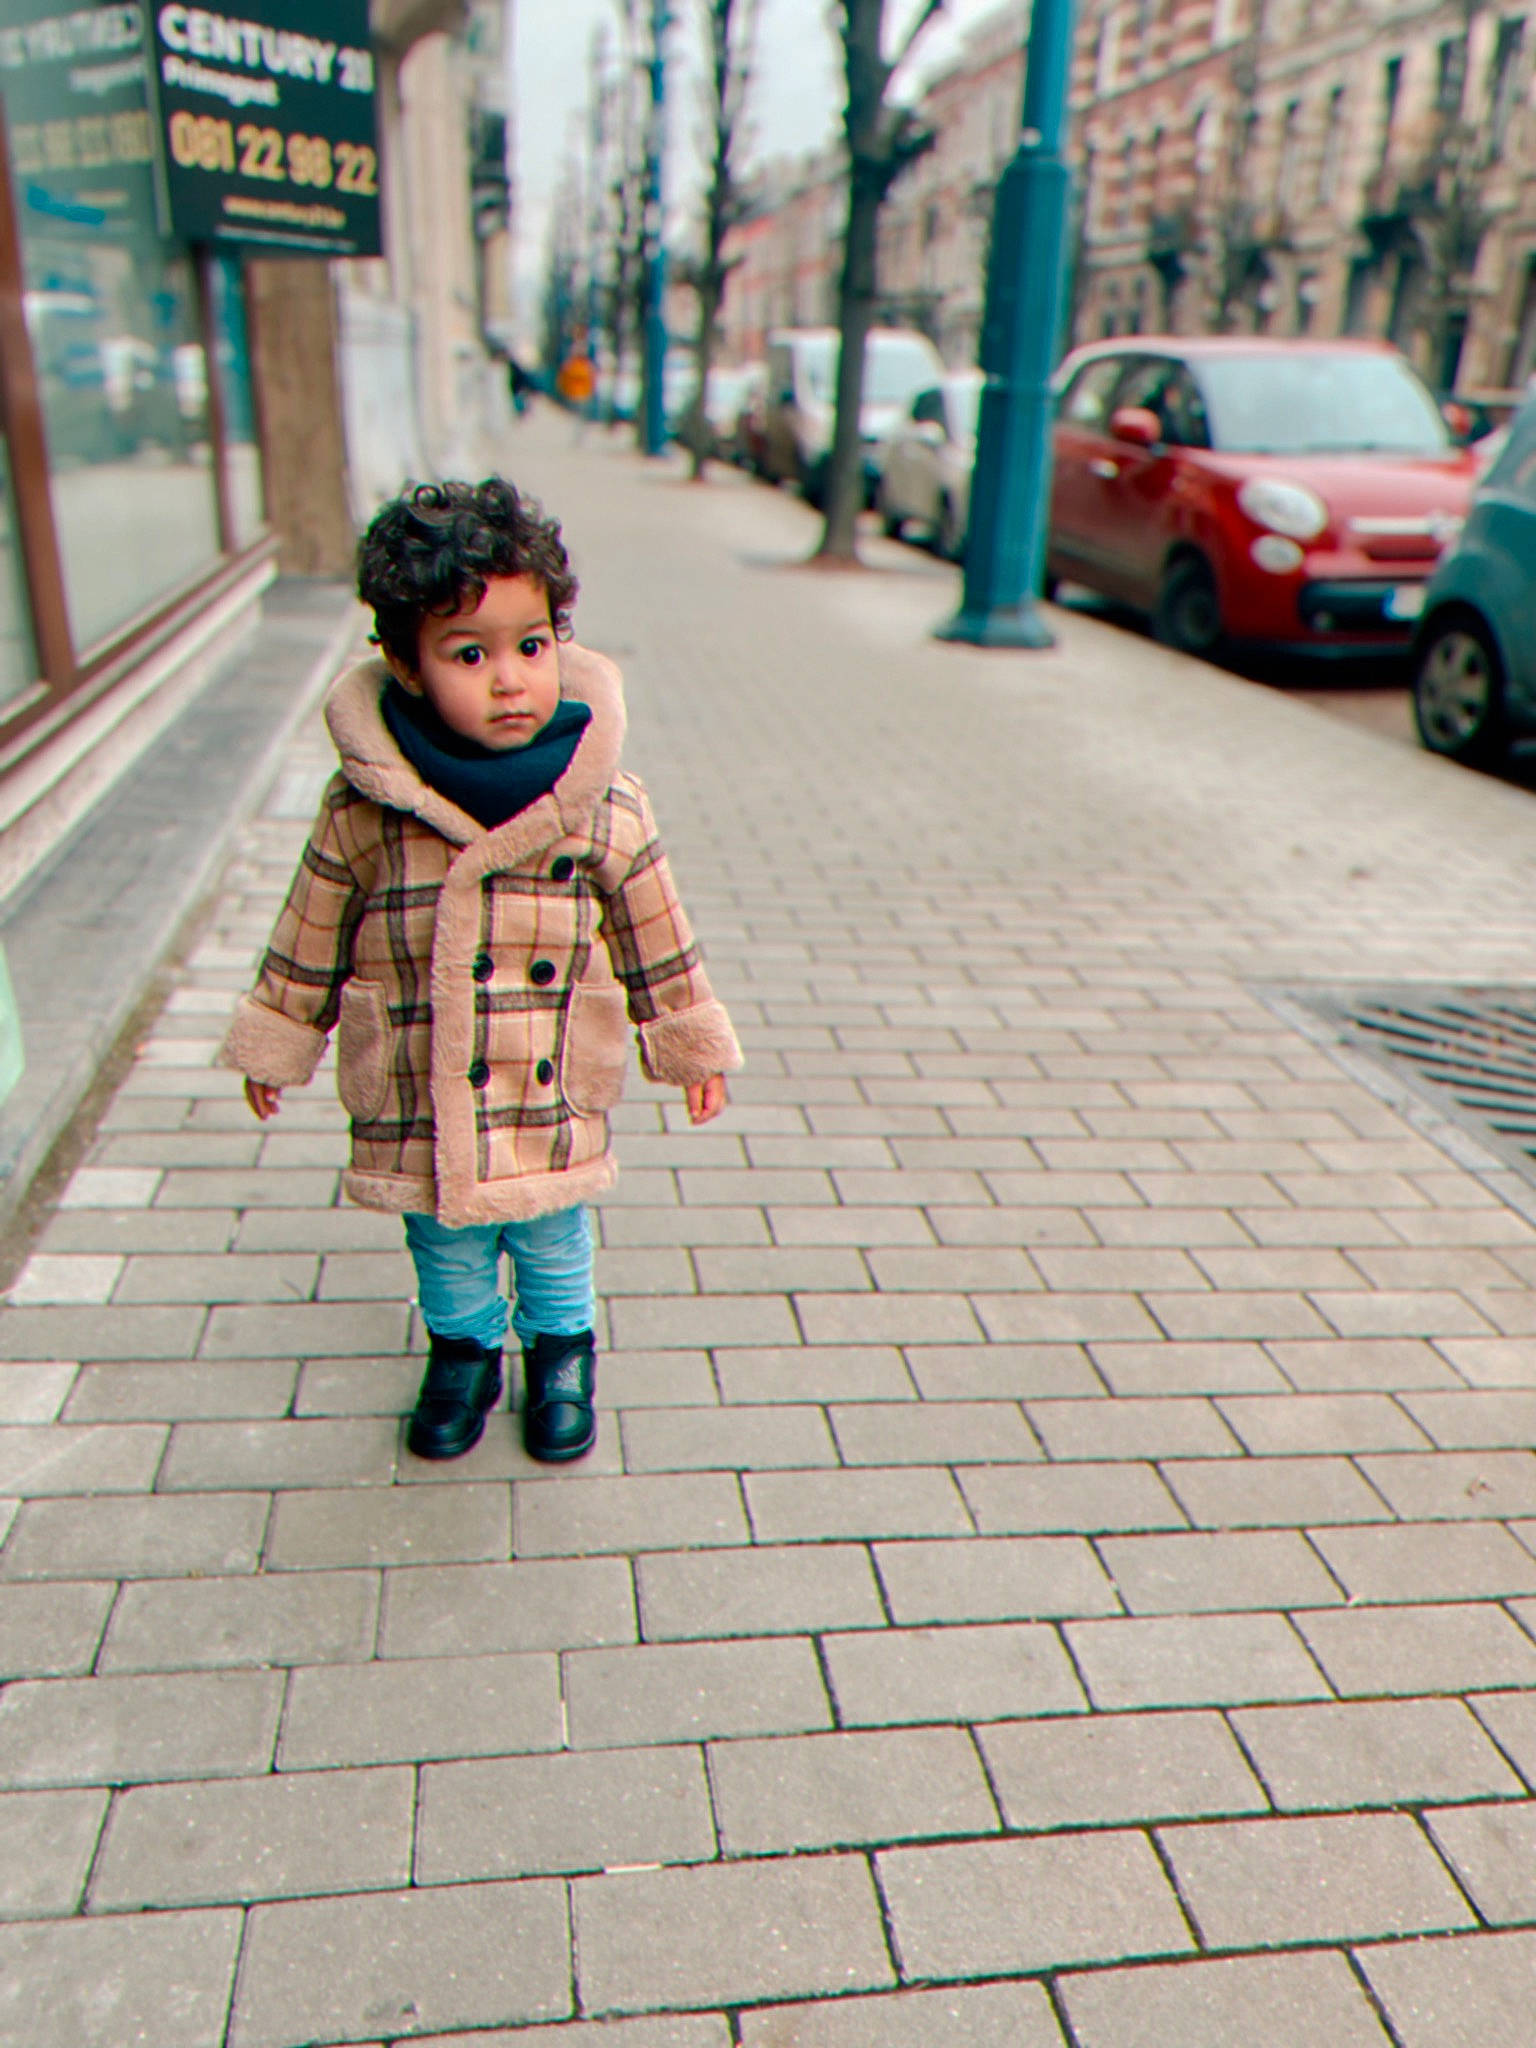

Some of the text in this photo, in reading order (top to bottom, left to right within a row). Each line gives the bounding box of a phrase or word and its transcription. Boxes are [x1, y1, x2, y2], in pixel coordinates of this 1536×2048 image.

[158, 3, 337, 84] CENTURY
[338, 48, 374, 94] 21
[169, 110, 235, 173] 081
[236, 123, 286, 182] 22
[333, 142, 378, 197] 22
